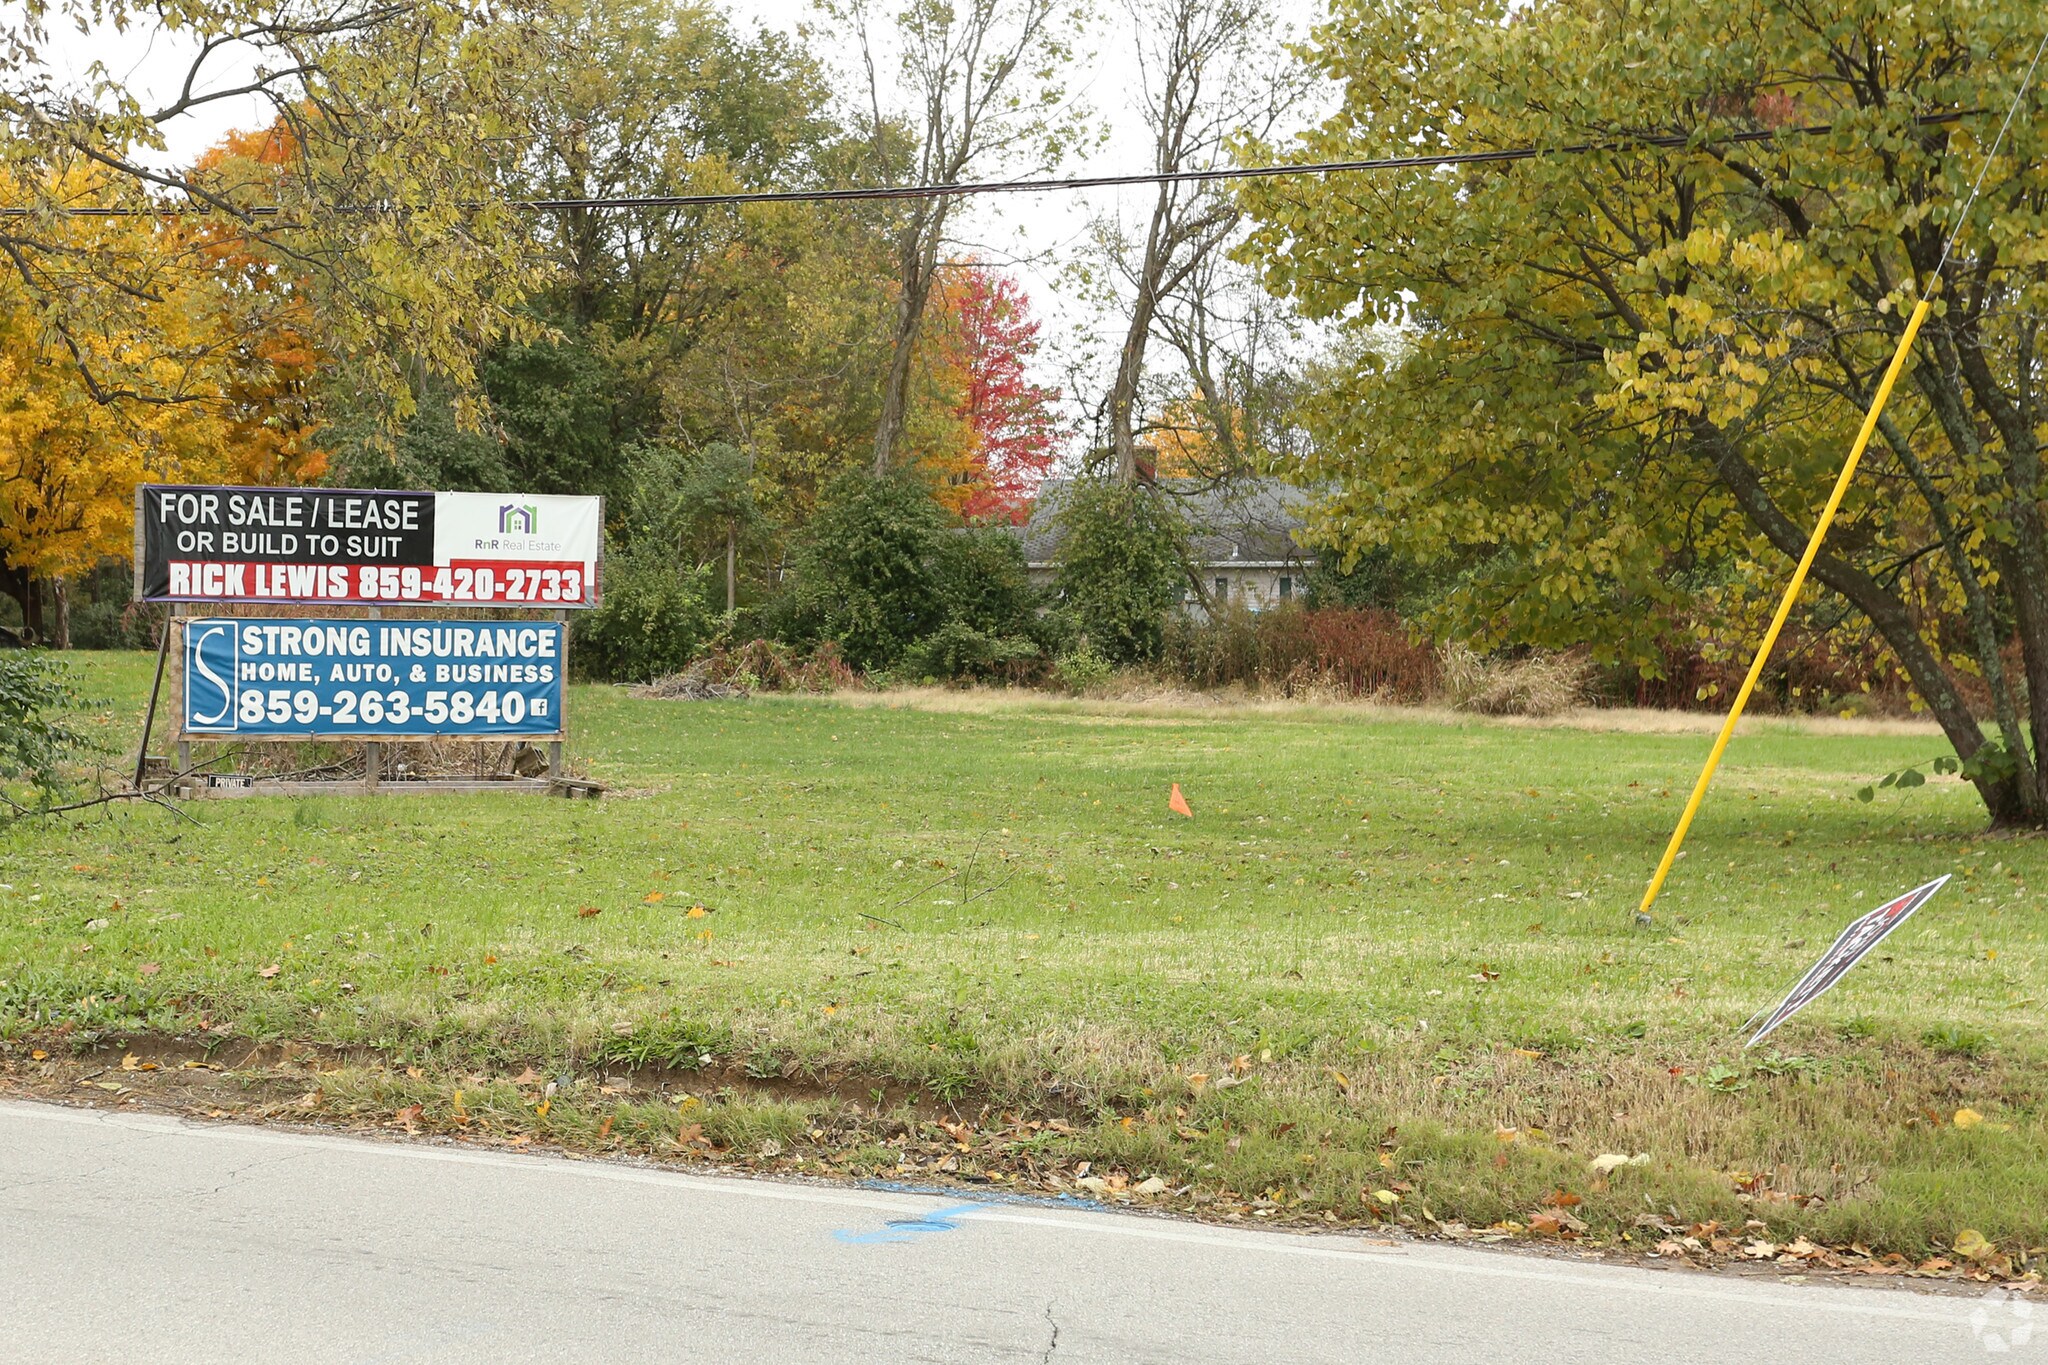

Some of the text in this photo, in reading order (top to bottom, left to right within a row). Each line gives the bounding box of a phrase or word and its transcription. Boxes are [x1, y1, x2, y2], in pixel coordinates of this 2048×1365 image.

[161, 494, 219, 524] FOR
[229, 495, 302, 526] SALE
[329, 499, 418, 529] LEASE
[177, 531, 402, 557] OR BUILD TO SUIT
[475, 539, 561, 551] RnR Real Estate
[170, 563, 580, 602] RICK LEWIS 859-420-2733
[242, 626, 555, 657] STRONG INSURANCE
[242, 663, 553, 686] HOME, AUTO, & BUSINESS
[240, 690, 525, 724] 859-263-5840
[215, 777, 245, 788] PRIVATE
